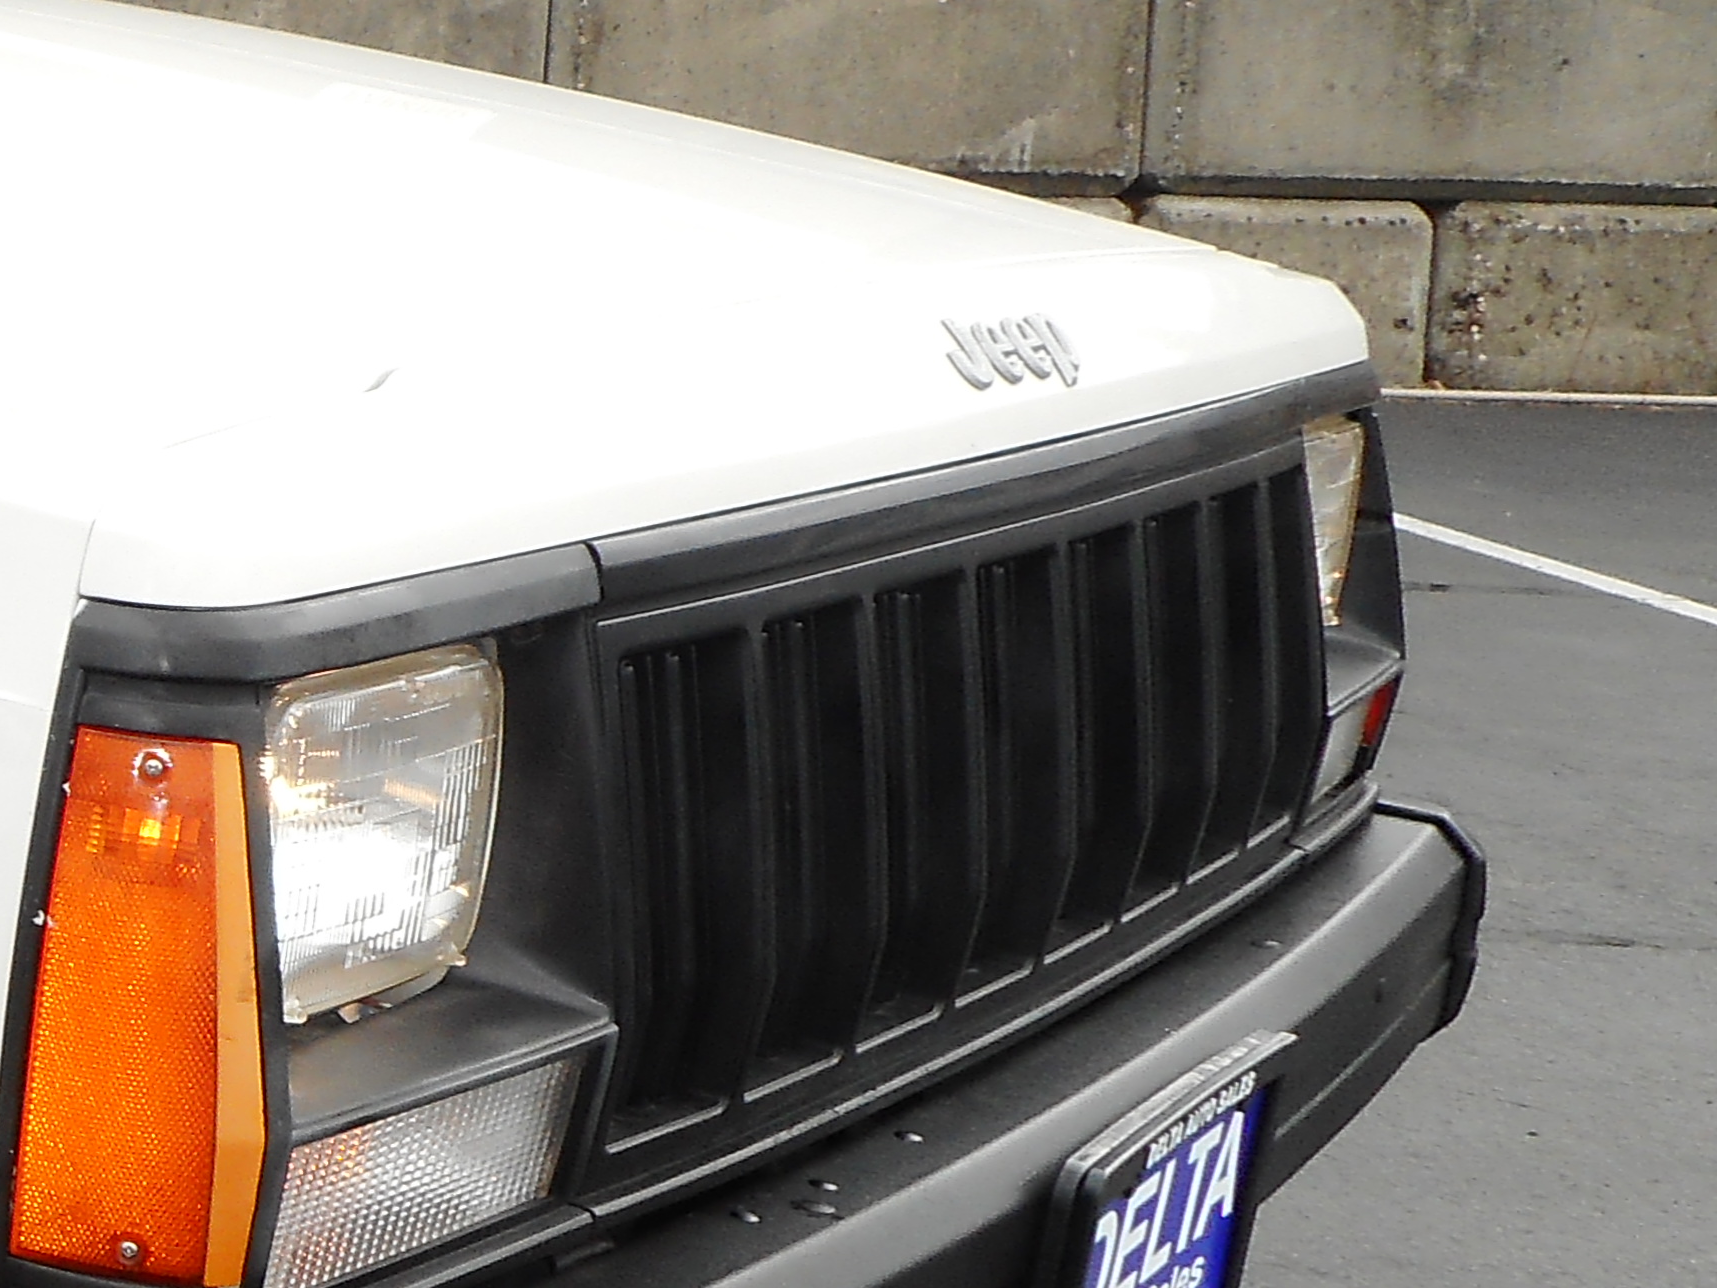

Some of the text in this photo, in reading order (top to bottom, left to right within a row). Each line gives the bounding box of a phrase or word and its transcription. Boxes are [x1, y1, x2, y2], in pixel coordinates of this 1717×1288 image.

[940, 313, 1080, 391] Jeep
[1146, 1121, 1185, 1169] DELTA
[1216, 1070, 1257, 1115] SALES
